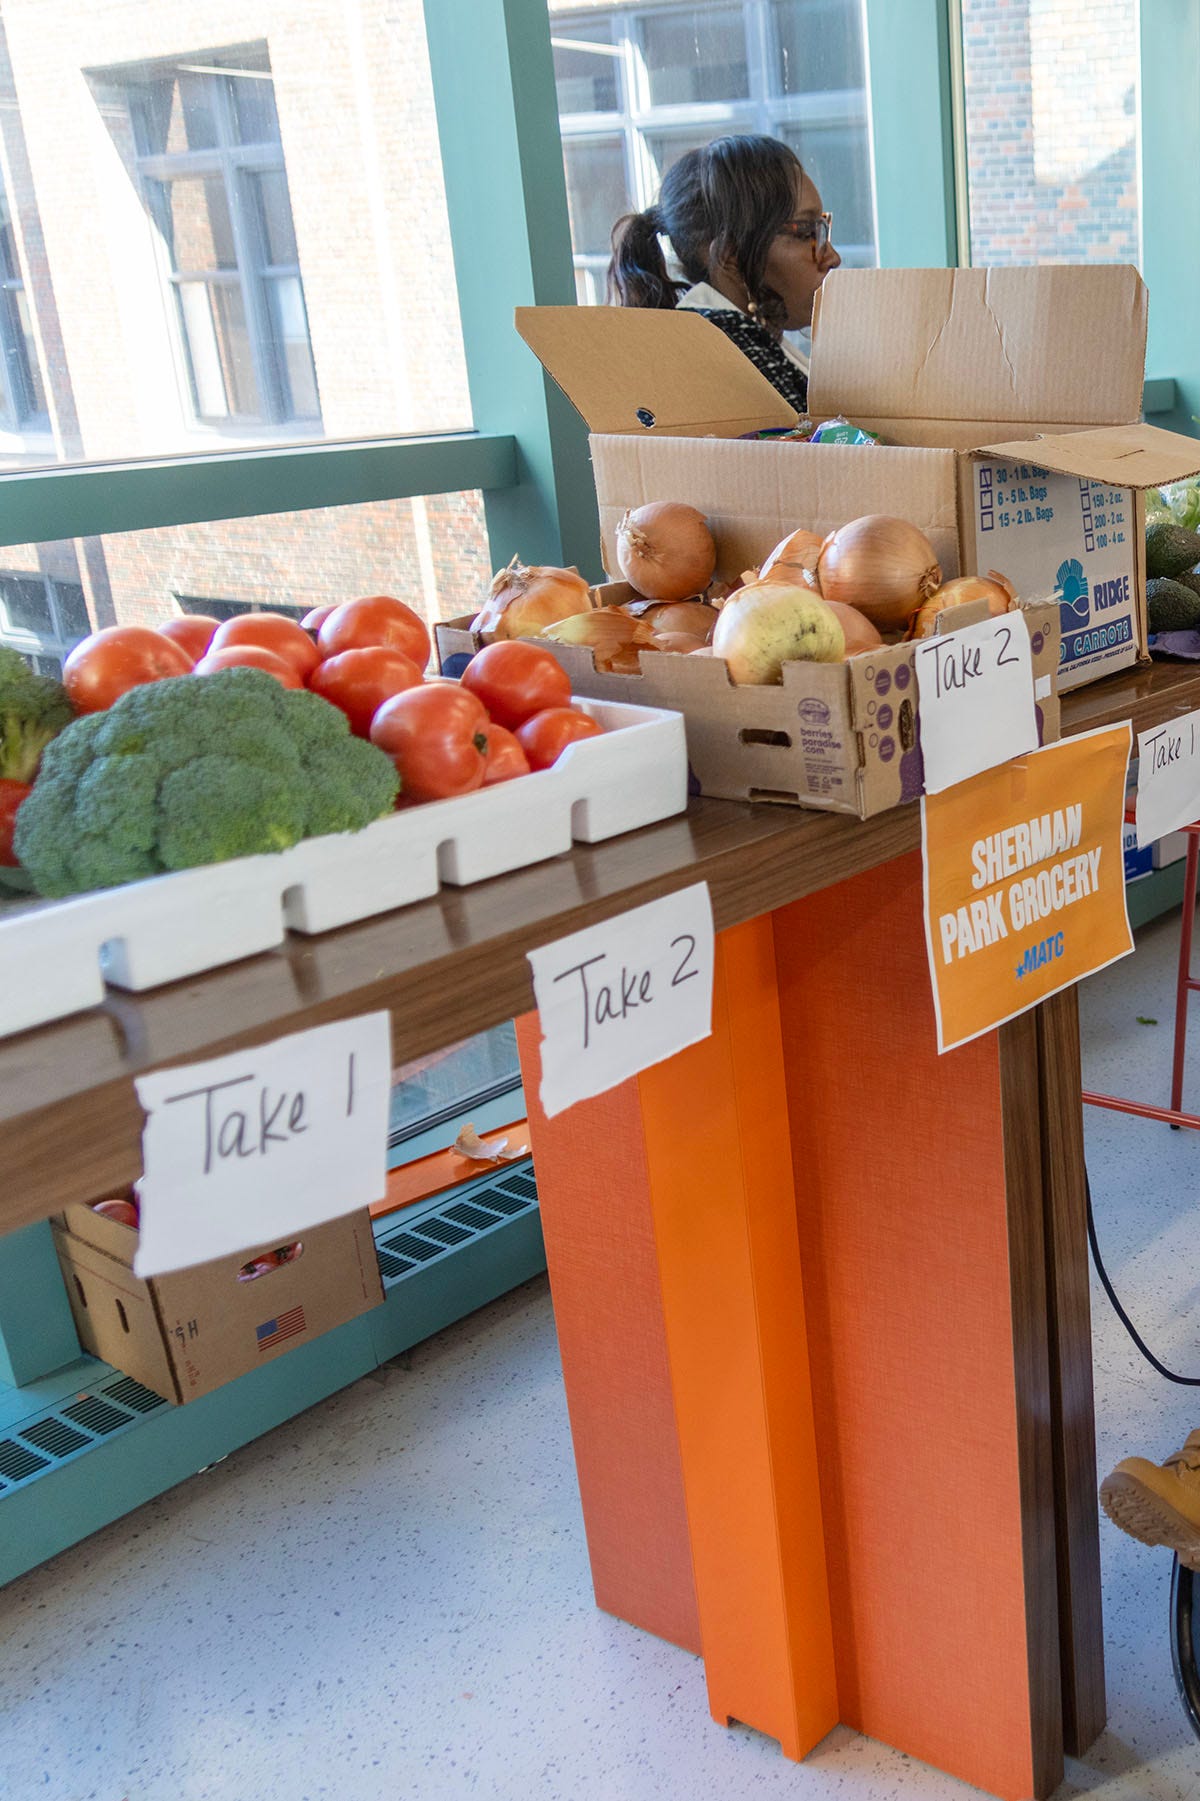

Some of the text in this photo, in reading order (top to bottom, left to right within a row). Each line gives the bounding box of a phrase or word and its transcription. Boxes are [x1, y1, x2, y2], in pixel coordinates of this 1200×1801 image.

[996, 468, 1007, 483] 30
[1014, 467, 1019, 480] 1
[997, 491, 1004, 505] 6
[1011, 489, 1016, 503] 5
[1029, 485, 1048, 501] Bags
[1109, 492, 1114, 504] 2
[999, 512, 1010, 527] 15
[1017, 510, 1023, 524] 2
[1036, 506, 1054, 521] Bags
[1111, 512, 1115, 525] 2
[1093, 575, 1130, 612] RIDGE
[1073, 619, 1129, 657] CARROTS
[923, 638, 984, 699] Take
[994, 628, 1019, 666] 2
[800, 727, 833, 739] berries
[802, 738, 842, 749] paradise
[1145, 724, 1196, 774] Take 1
[971, 804, 1083, 890] SHERMAN
[939, 847, 1103, 965] PARK GROCERY
[1022, 931, 1065, 973] MATC
[553, 935, 700, 1050] Take 2
[164, 1052, 356, 1174] Take 1
